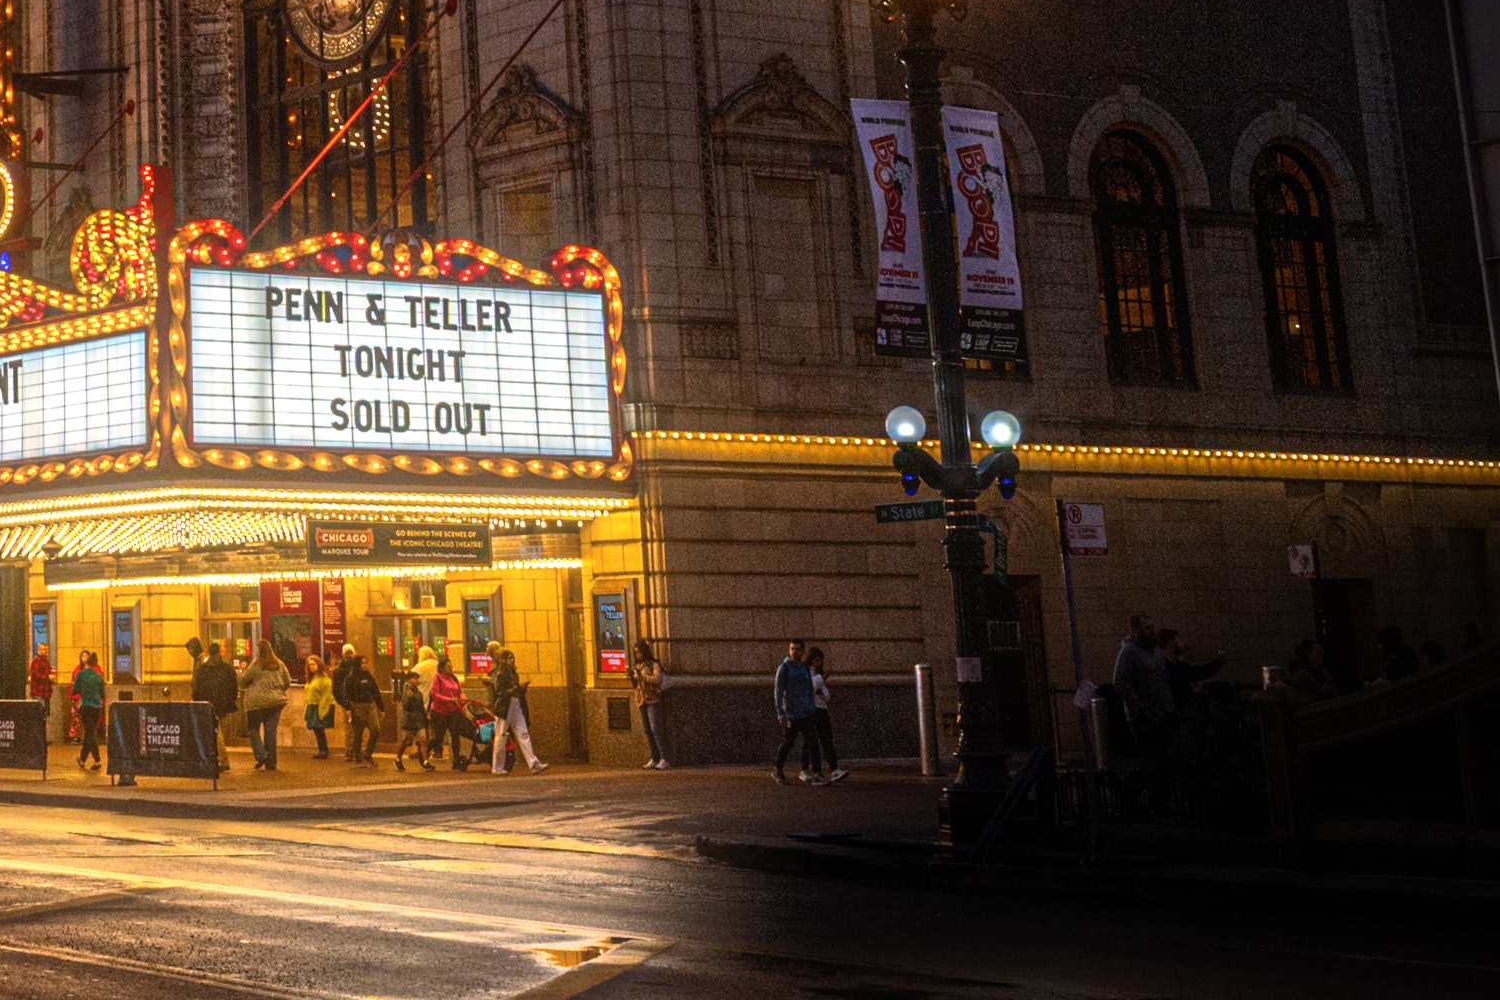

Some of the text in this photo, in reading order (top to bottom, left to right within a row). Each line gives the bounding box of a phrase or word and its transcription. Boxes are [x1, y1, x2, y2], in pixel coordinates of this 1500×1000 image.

[265, 286, 513, 333] PENN & TELLER
[334, 344, 466, 382] TONIGHT
[330, 398, 491, 436] SOLD OUT
[890, 505, 925, 520] State
[929, 505, 940, 516] St
[322, 533, 367, 543] CHICAGO
[395, 529, 406, 537] GO
[406, 530, 430, 538] BEHIND
[431, 530, 443, 538] THE
[467, 531, 477, 539] OF
[389, 539, 401, 548] THE
[403, 540, 425, 548] ICONIC
[426, 540, 455, 549] CHICAGO
[321, 548, 369, 556] MARQUEE TOUR
[147, 716, 157, 724] THE
[147, 724, 181, 734] CHICAGO
[147, 735, 181, 746] THEATRE
